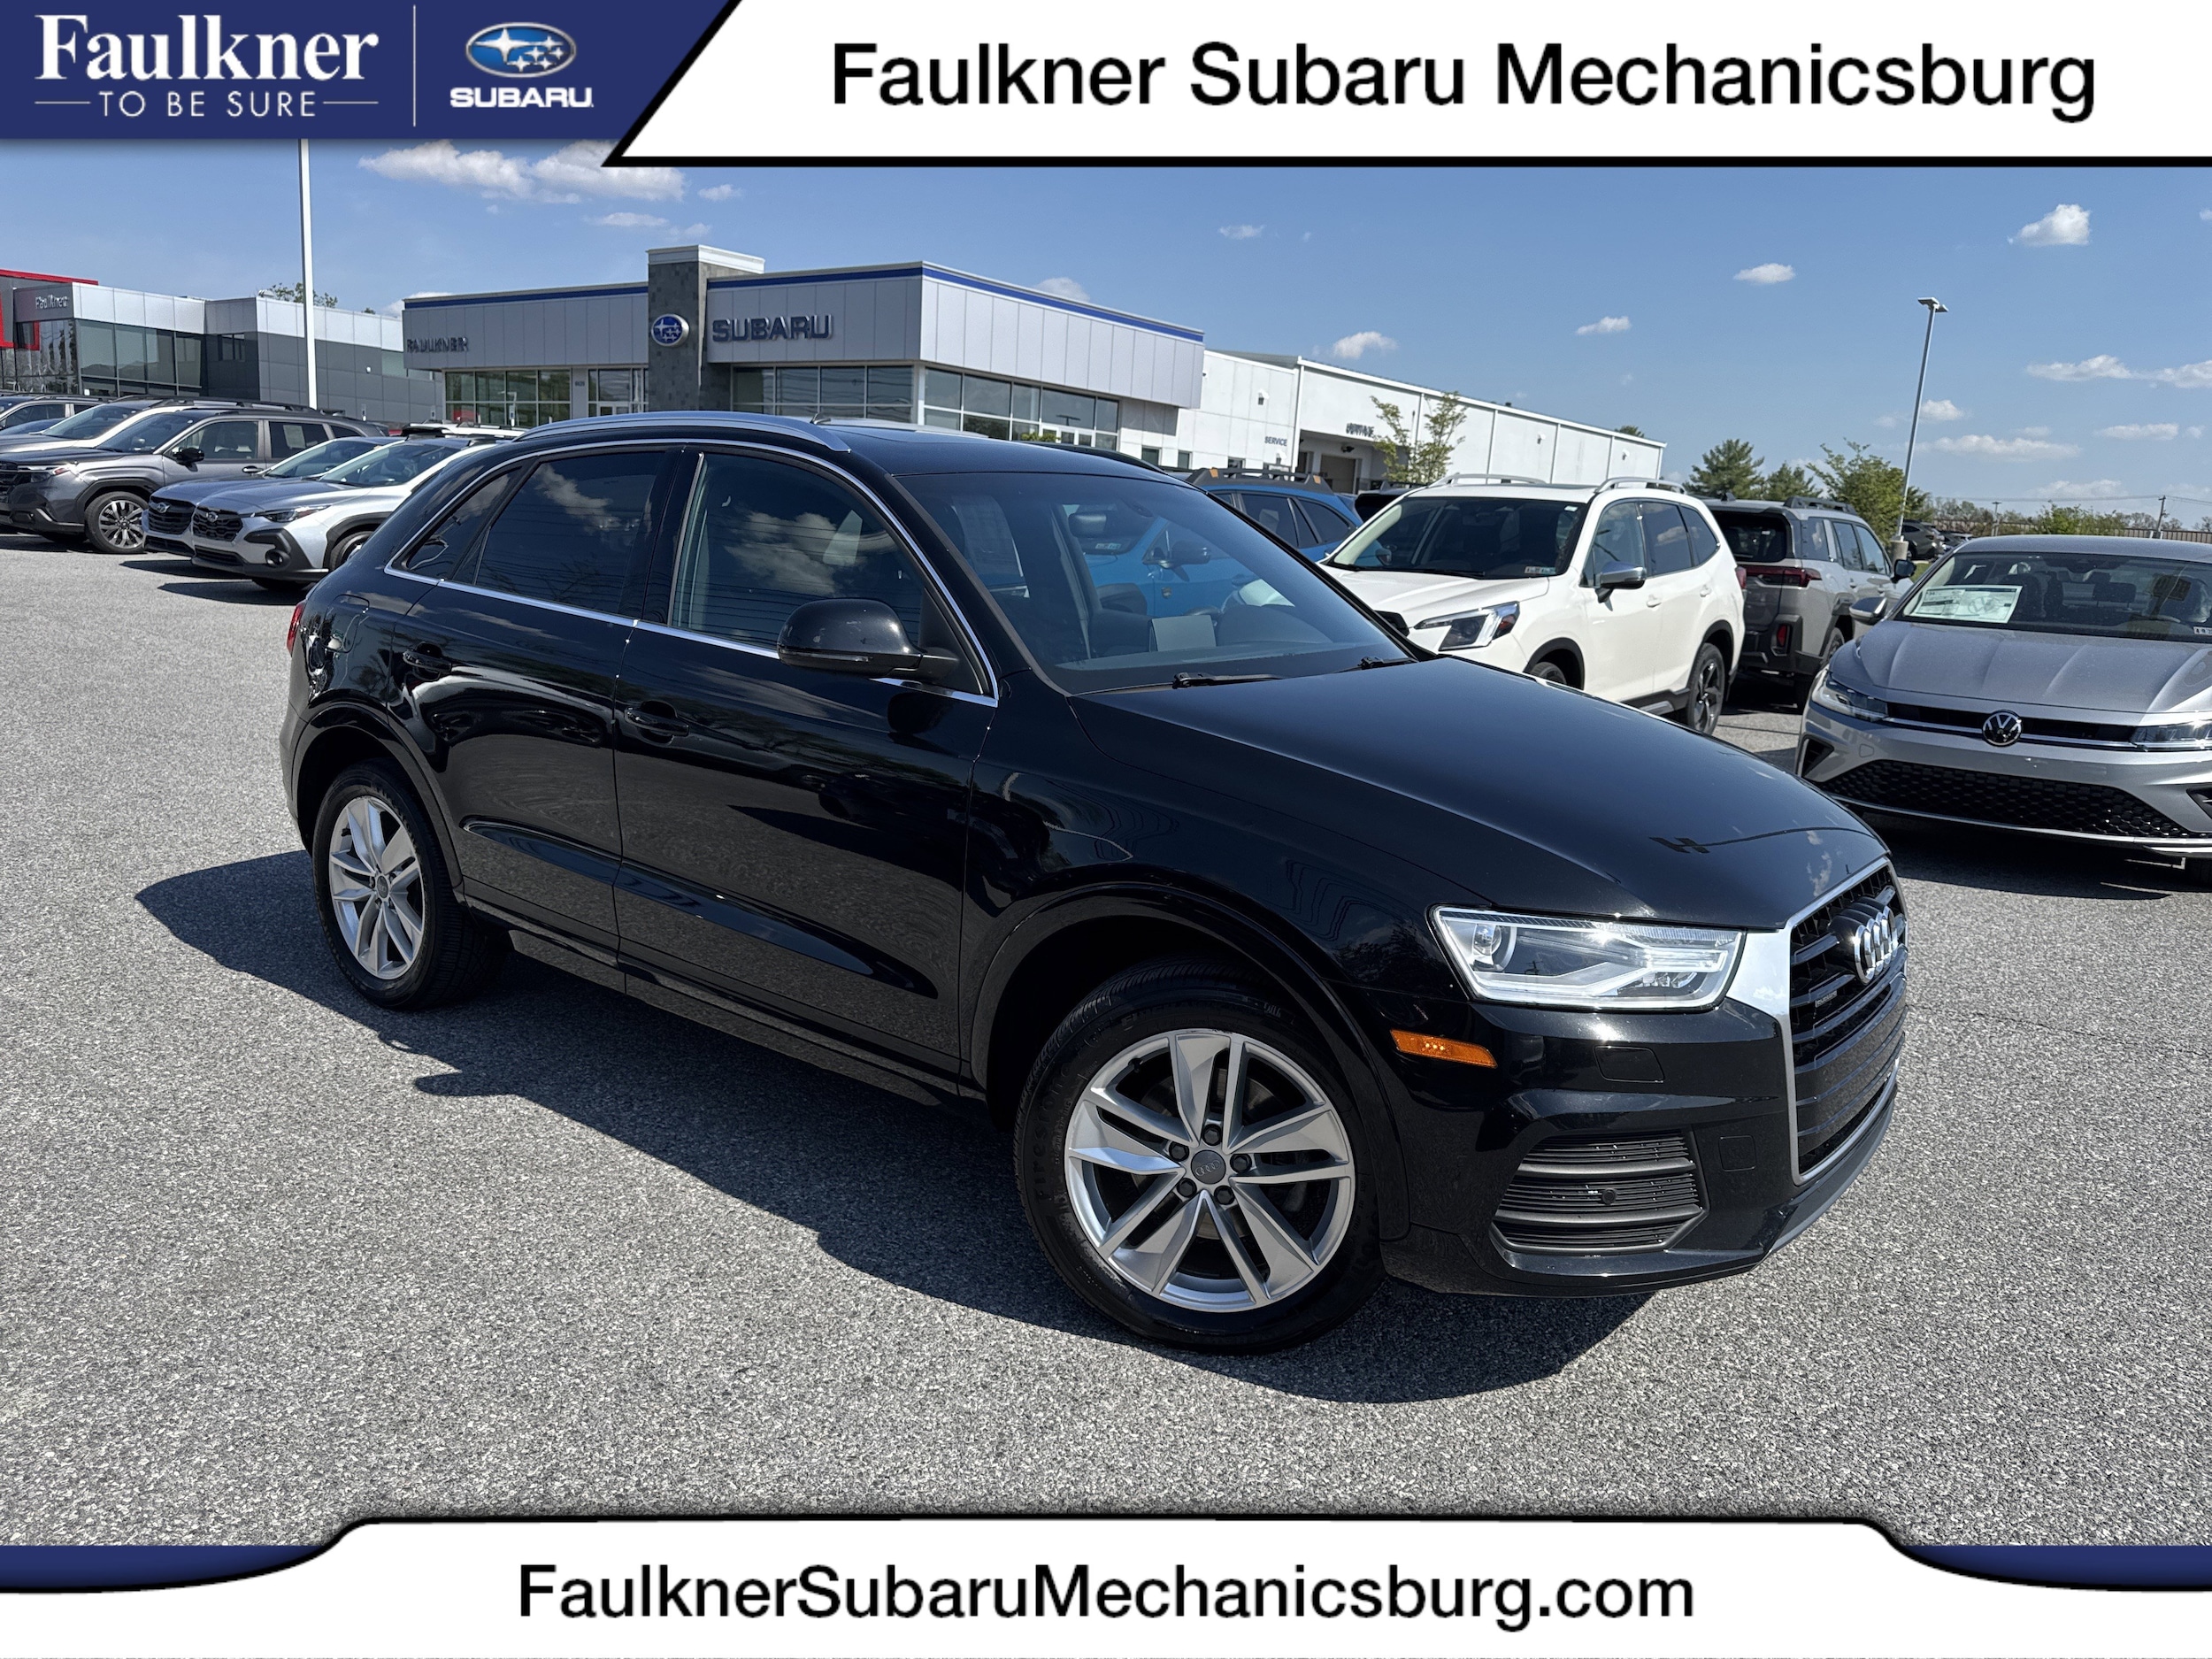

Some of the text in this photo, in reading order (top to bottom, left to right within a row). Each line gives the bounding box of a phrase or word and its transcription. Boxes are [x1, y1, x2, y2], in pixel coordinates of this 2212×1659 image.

[711, 314, 833, 342] SUBARU
[406, 336, 468, 353] FAULKNER
[1264, 435, 1287, 447] SERVICE
